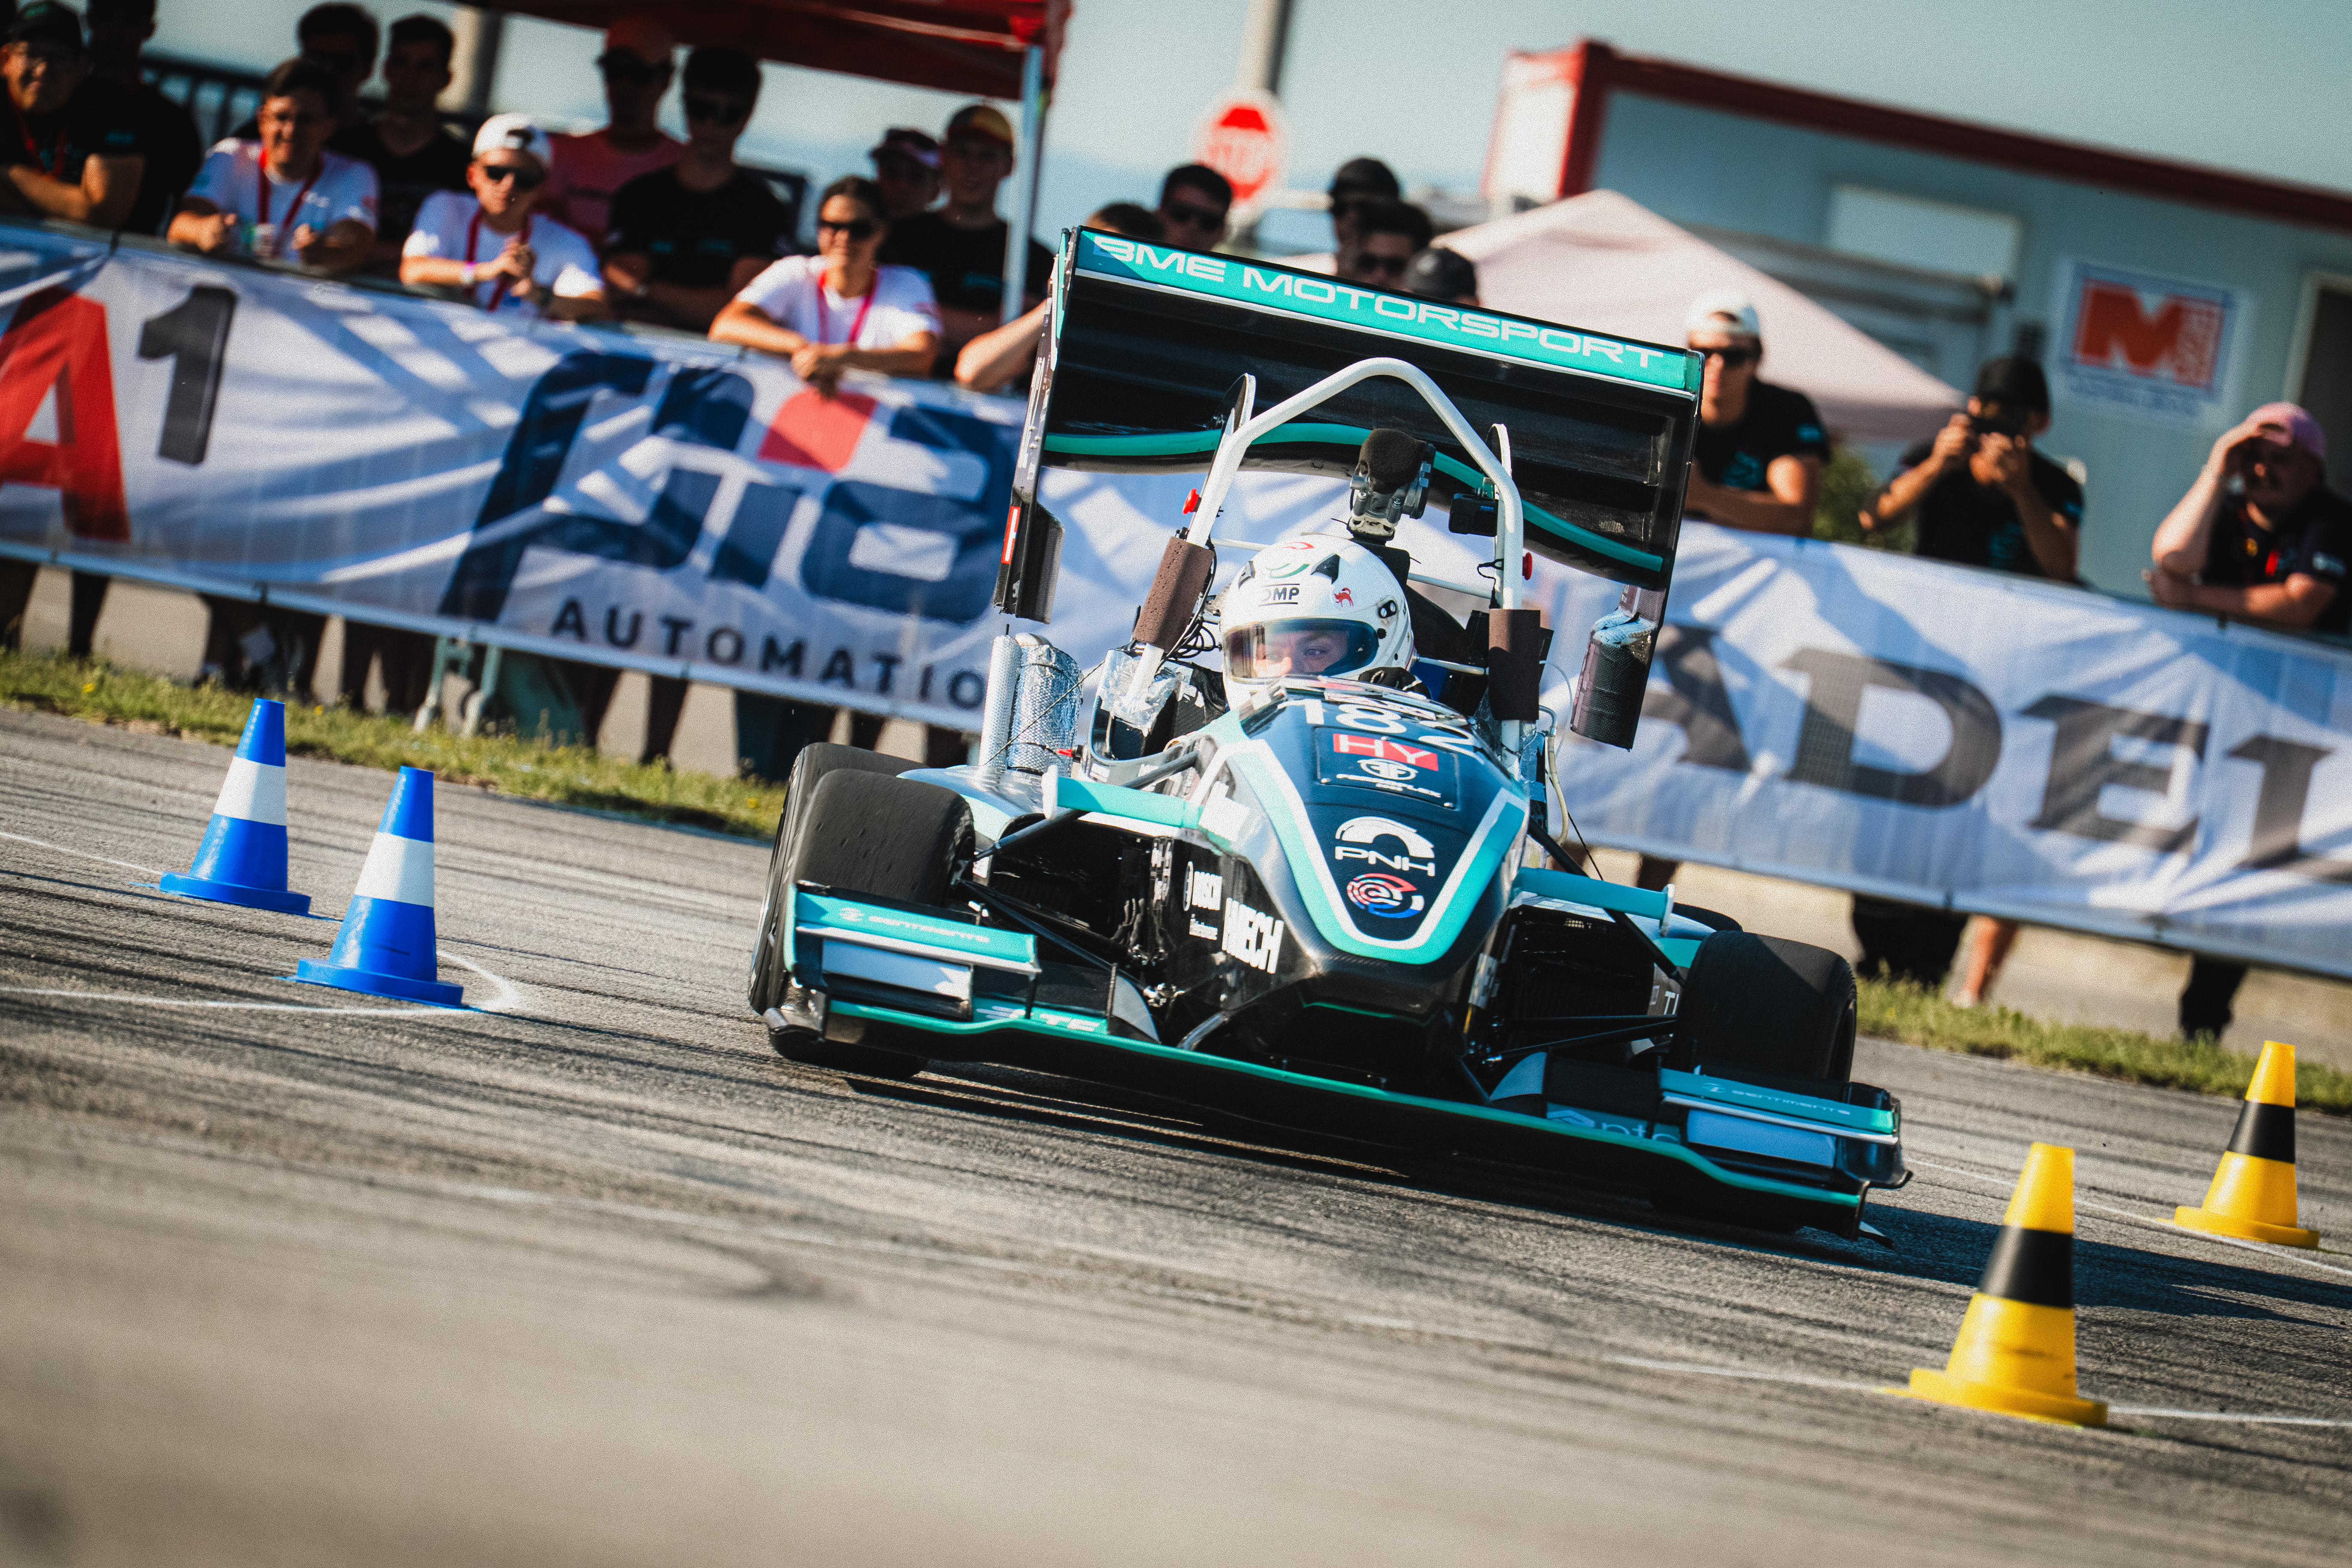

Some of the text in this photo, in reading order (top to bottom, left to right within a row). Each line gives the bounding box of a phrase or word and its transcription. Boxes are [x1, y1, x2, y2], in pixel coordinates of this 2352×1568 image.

[1093, 235, 1664, 368] BME MOTORSPORT
[551, 594, 988, 712] AUTOMATIO
[1277, 698, 1485, 765] 182
[1339, 734, 1431, 764] HY
[1335, 846, 1436, 877] PNH
